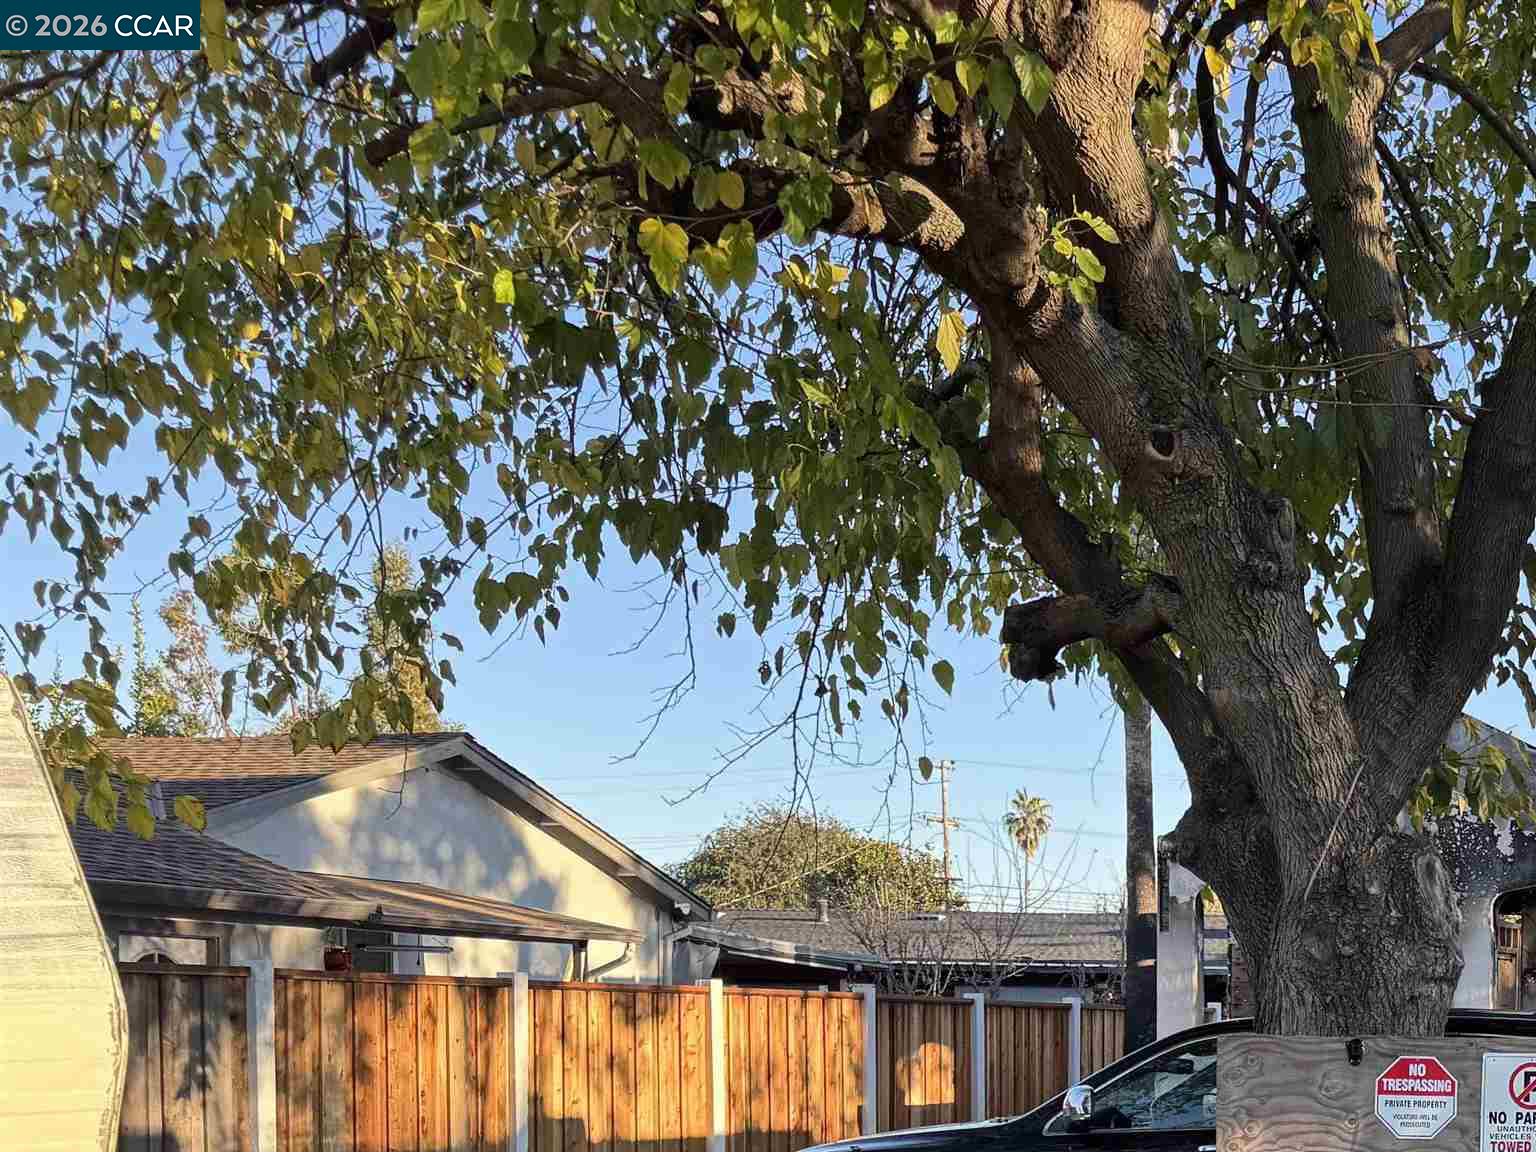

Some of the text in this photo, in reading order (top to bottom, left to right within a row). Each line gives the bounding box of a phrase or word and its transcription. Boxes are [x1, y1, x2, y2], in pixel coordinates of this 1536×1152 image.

[1408, 1063, 1426, 1077] NO
[1382, 1078, 1452, 1092] TRESPASSING
[1384, 1099, 1448, 1109] PRIVATE PROPERTY
[1488, 1112, 1507, 1125] NO
[1489, 1141, 1532, 1152] TOWED
